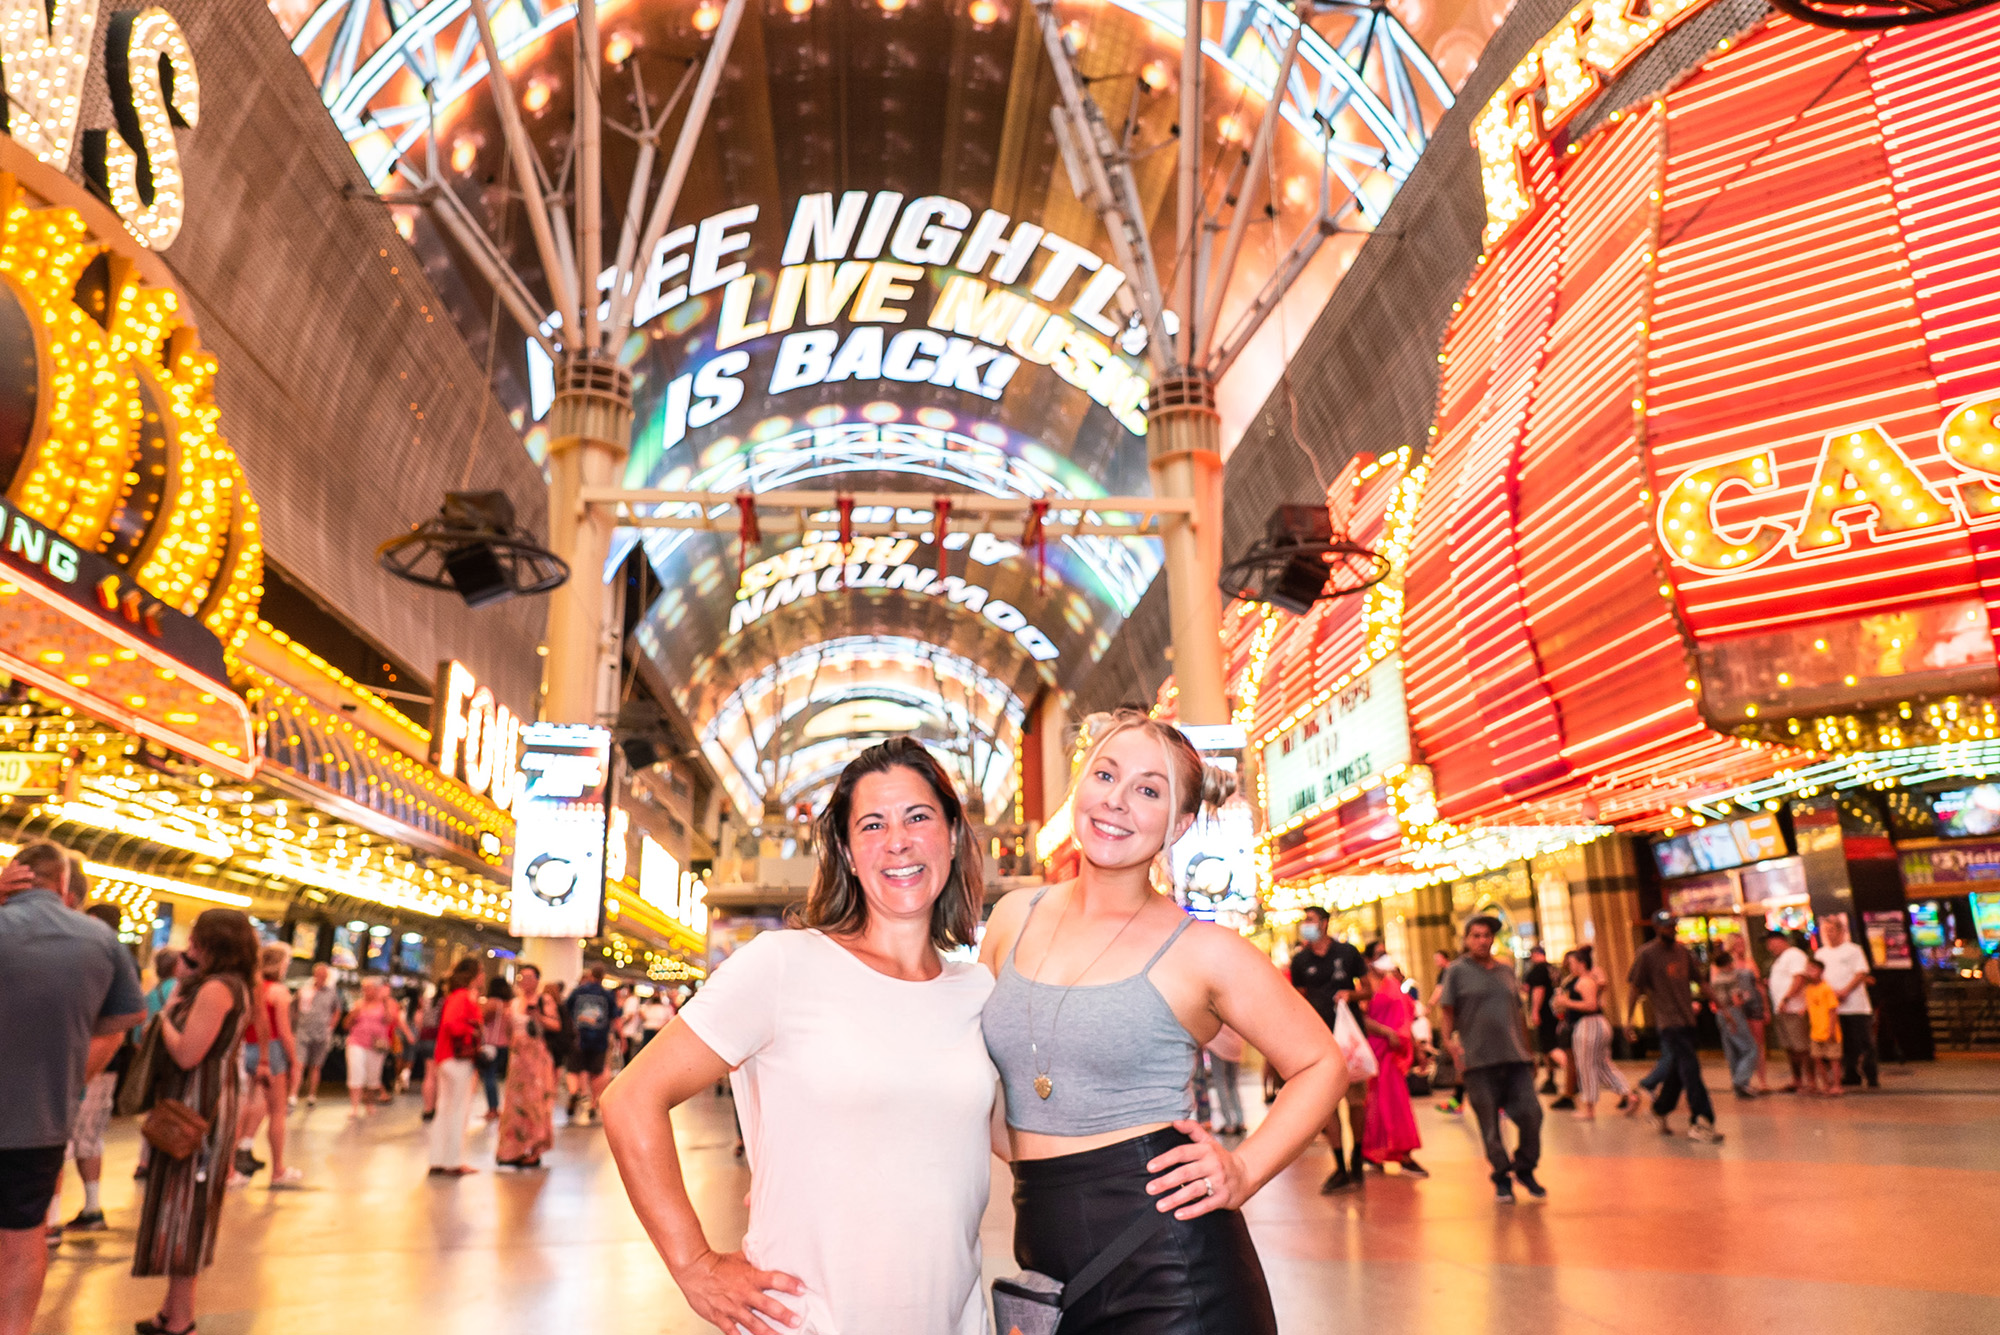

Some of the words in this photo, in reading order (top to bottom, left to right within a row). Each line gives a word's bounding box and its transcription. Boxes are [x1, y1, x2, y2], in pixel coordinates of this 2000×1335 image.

[715, 260, 925, 351] LIVE
[663, 350, 750, 450] IS
[768, 326, 1021, 400] BACK!
